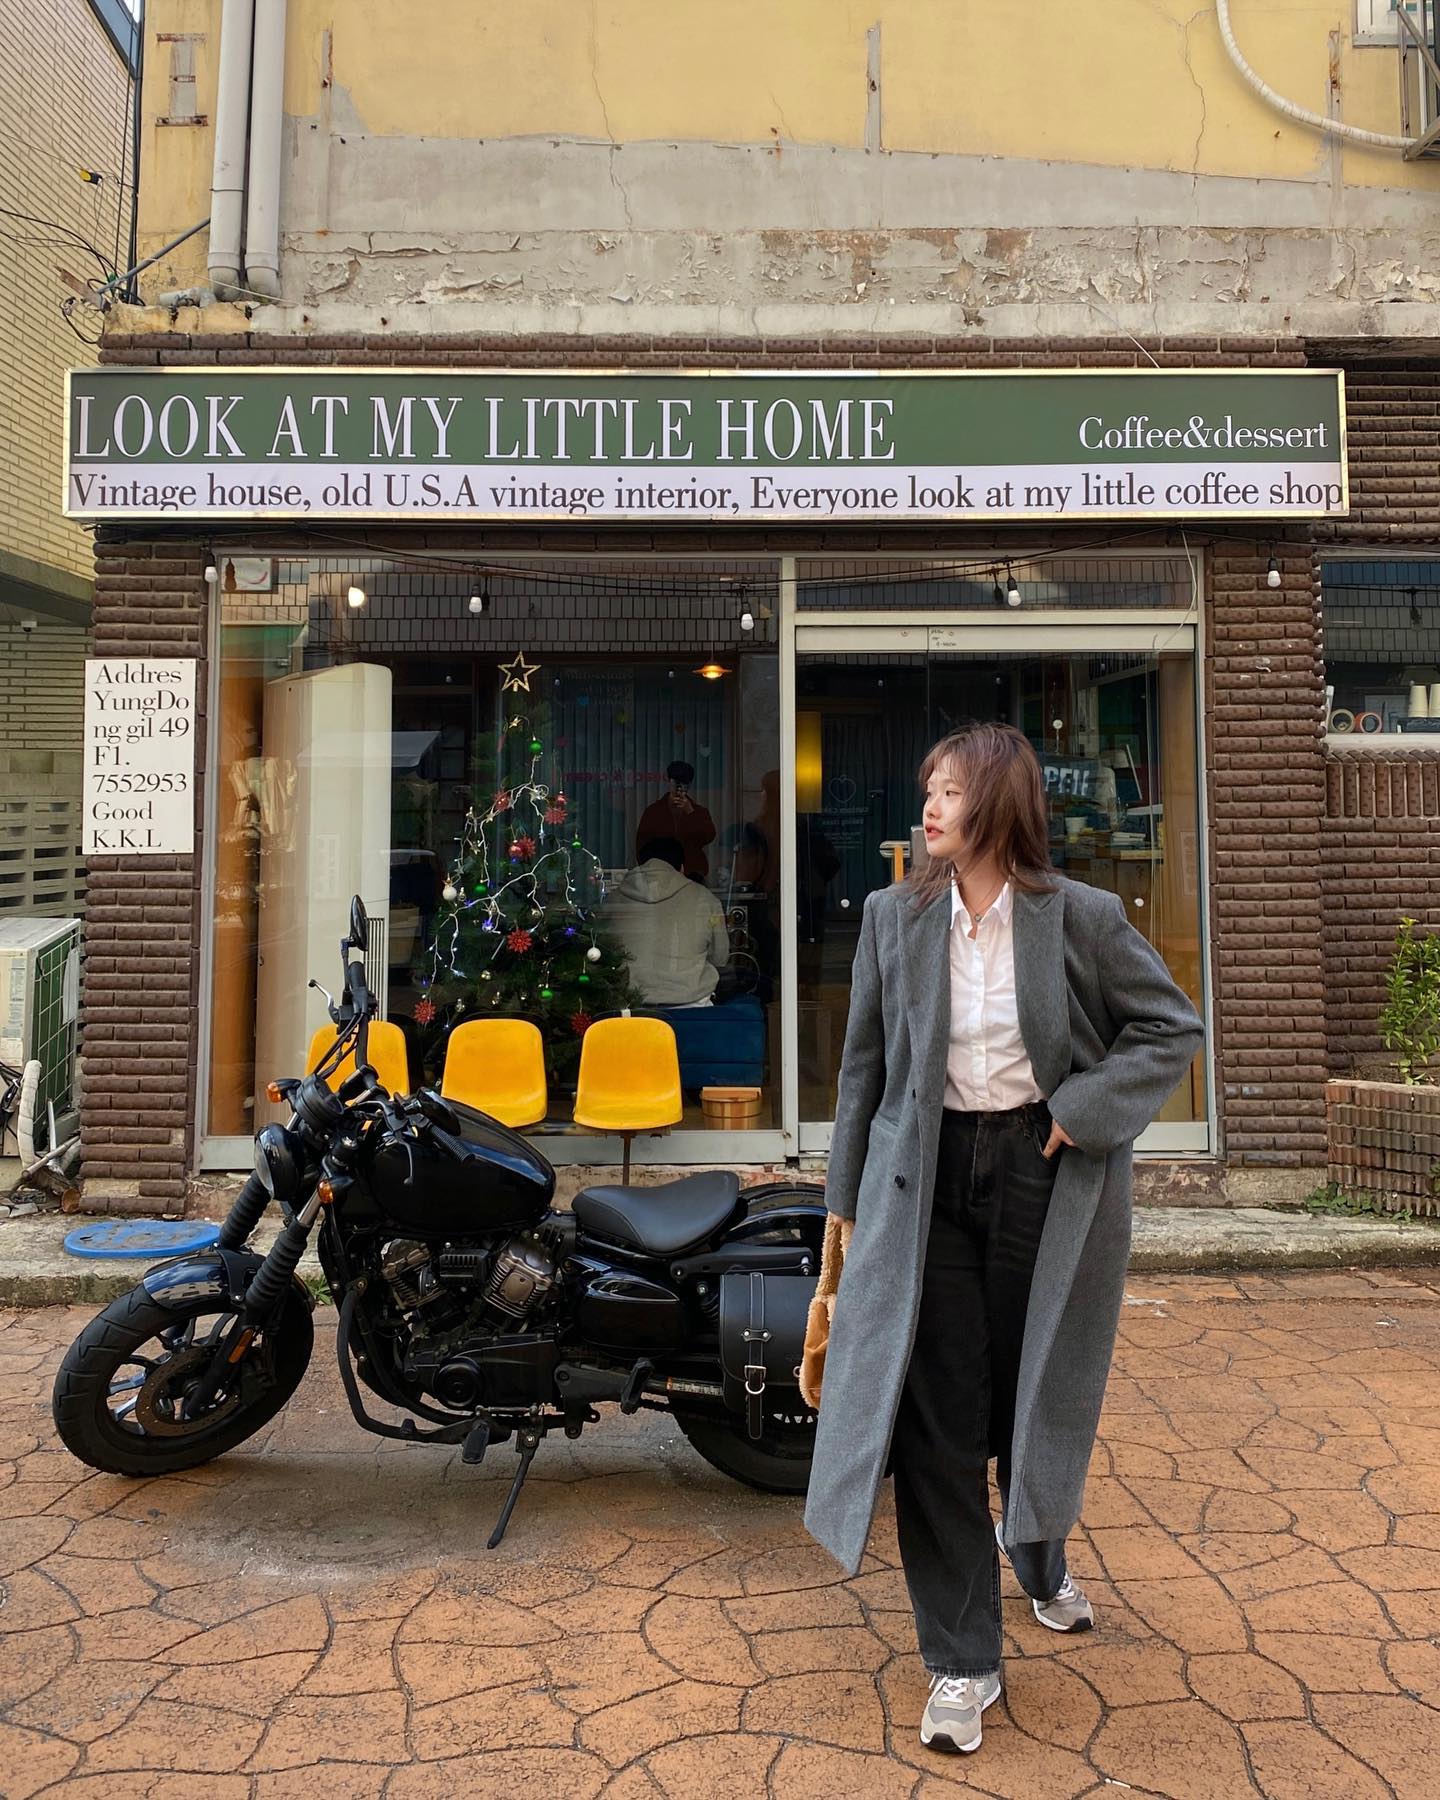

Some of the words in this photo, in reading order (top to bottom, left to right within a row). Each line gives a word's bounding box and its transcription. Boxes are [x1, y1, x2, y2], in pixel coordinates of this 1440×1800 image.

[74, 395, 246, 458] LOOK
[266, 395, 349, 457] AT
[368, 396, 463, 458] MY
[484, 398, 693, 461] LITTLE
[715, 398, 896, 461] HOME
[1078, 415, 1329, 449] Coffee&dessert
[70, 473, 197, 512] Vintage
[206, 472, 311, 512] house,
[322, 473, 373, 507] old
[384, 473, 480, 507] U.S.A
[489, 475, 605, 514] vintage
[614, 476, 740, 514] interior,
[750, 476, 899, 514] Everyone
[907, 474, 975, 509] look
[985, 481, 1015, 508] at
[1023, 485, 1073, 513] my
[1081, 472, 1155, 506] little
[1165, 471, 1260, 505] coffee
[1269, 471, 1343, 511] shop
[93, 663, 182, 685] Addres
[91, 689, 190, 717] YungDo
[93, 724, 122, 745] ng
[126, 717, 154, 745] gil
[158, 716, 190, 738] 49
[91, 772, 188, 793] 7552953
[1041, 765, 1090, 796] PEN
[91, 800, 153, 821] Good
[91, 828, 162, 849] K.K.L
